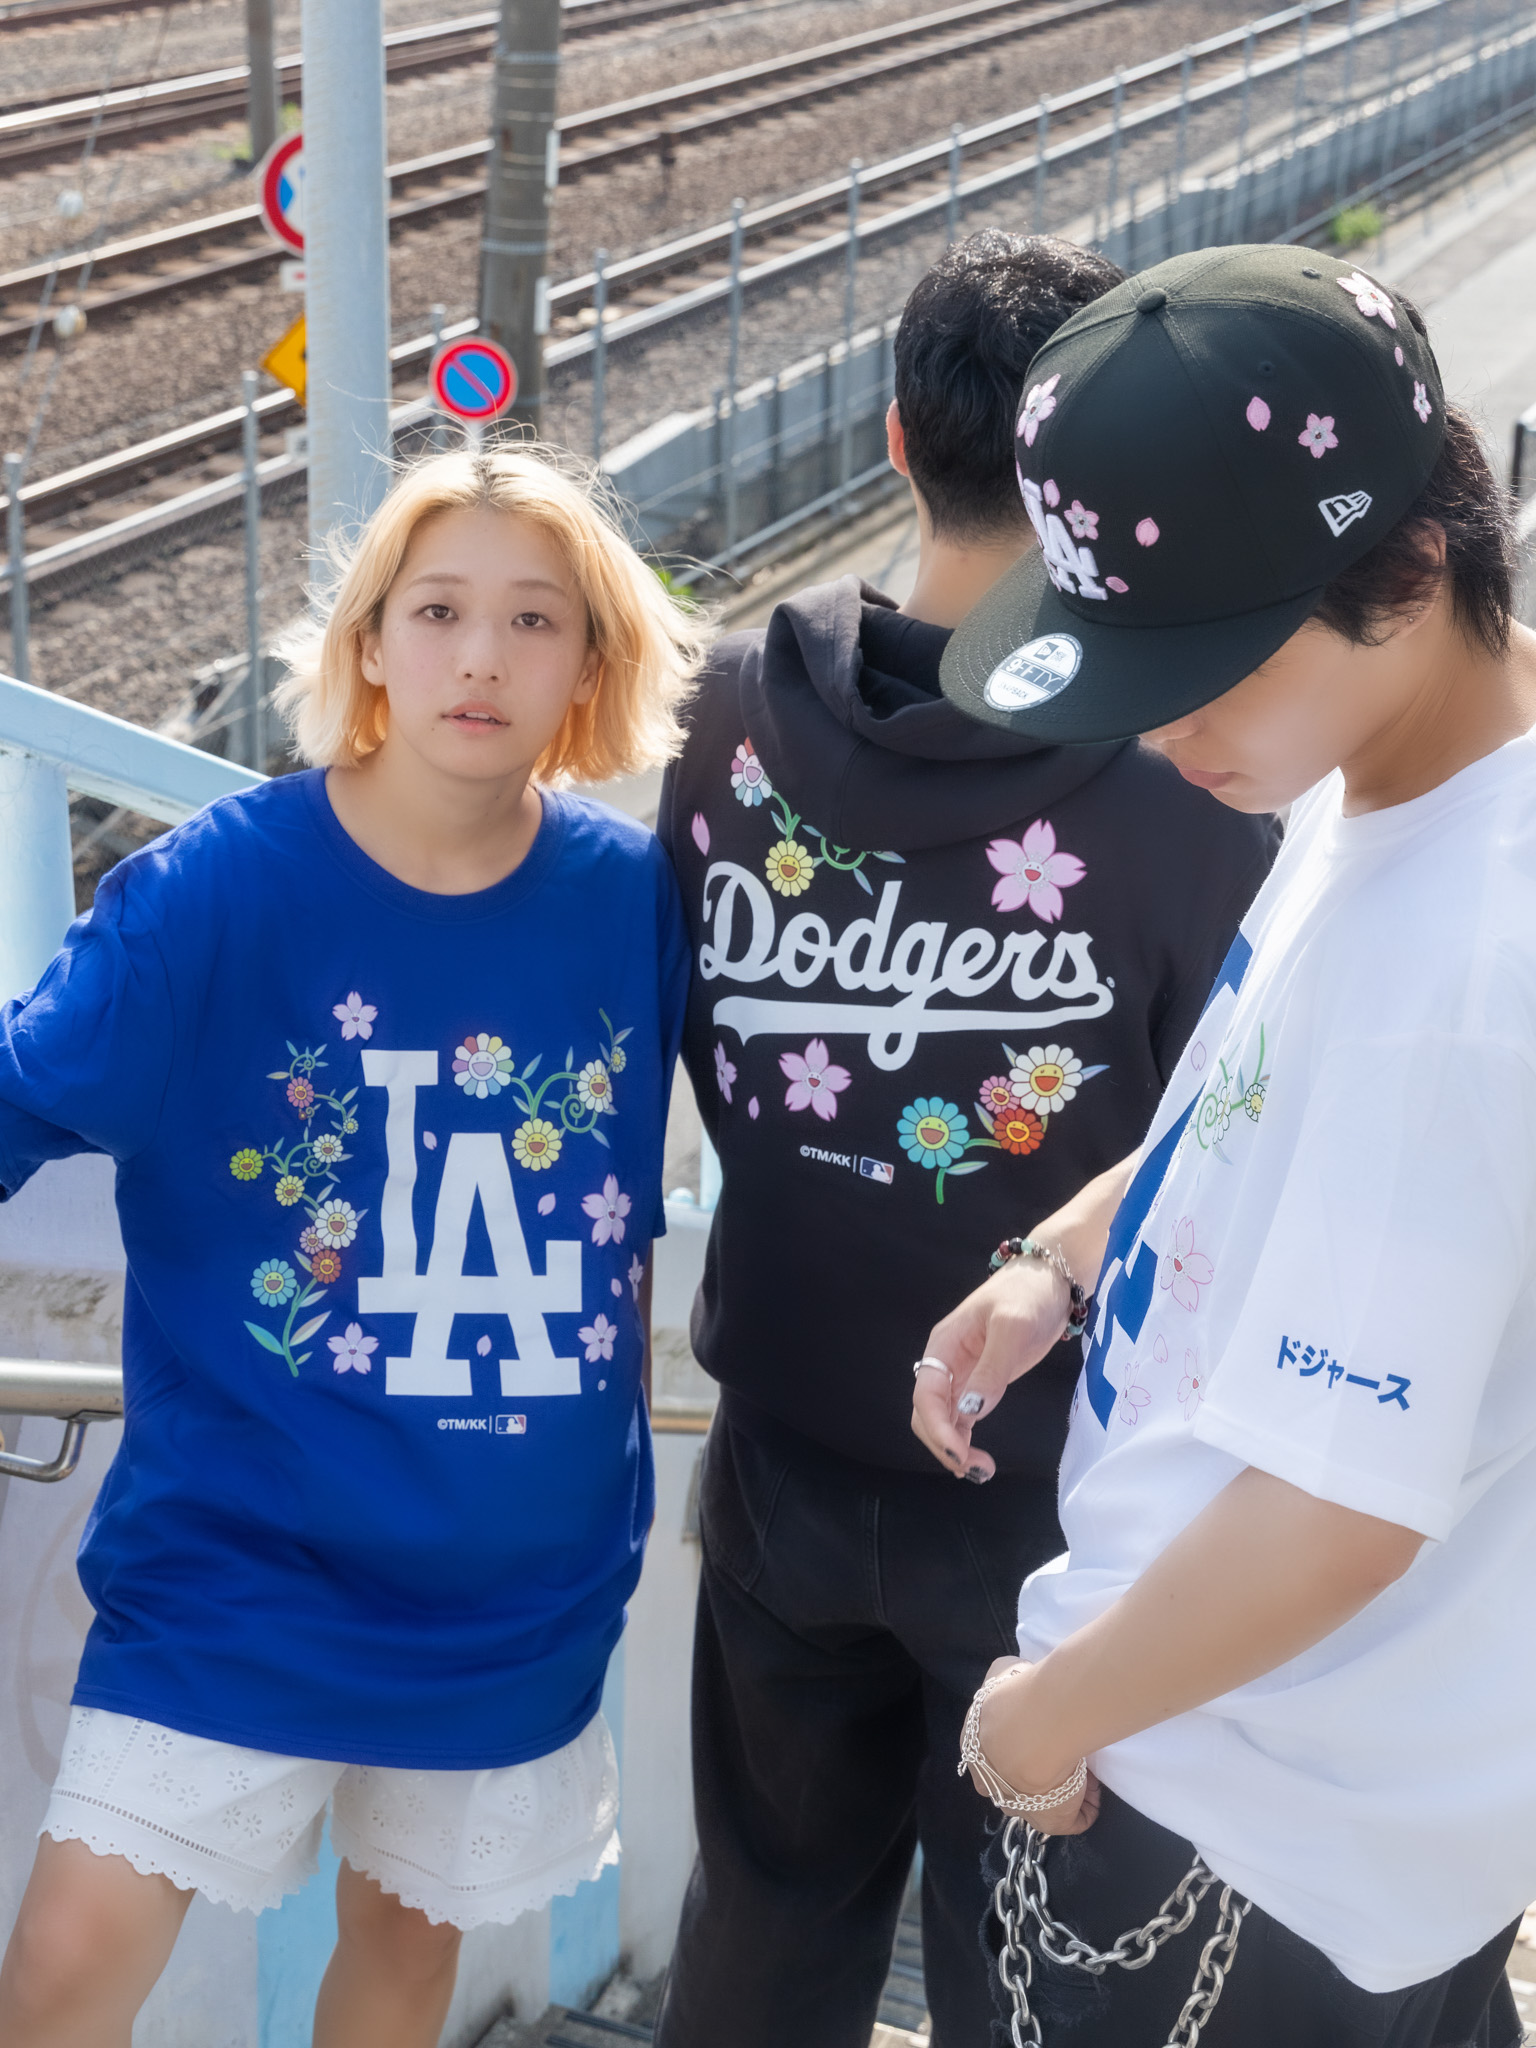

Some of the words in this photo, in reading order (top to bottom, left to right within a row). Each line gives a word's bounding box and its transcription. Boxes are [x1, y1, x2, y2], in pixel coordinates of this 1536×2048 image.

[700, 861, 1114, 1071] Dodgers
[358, 1049, 582, 1396] LA
[1277, 1335, 1411, 1411] ドジャース
